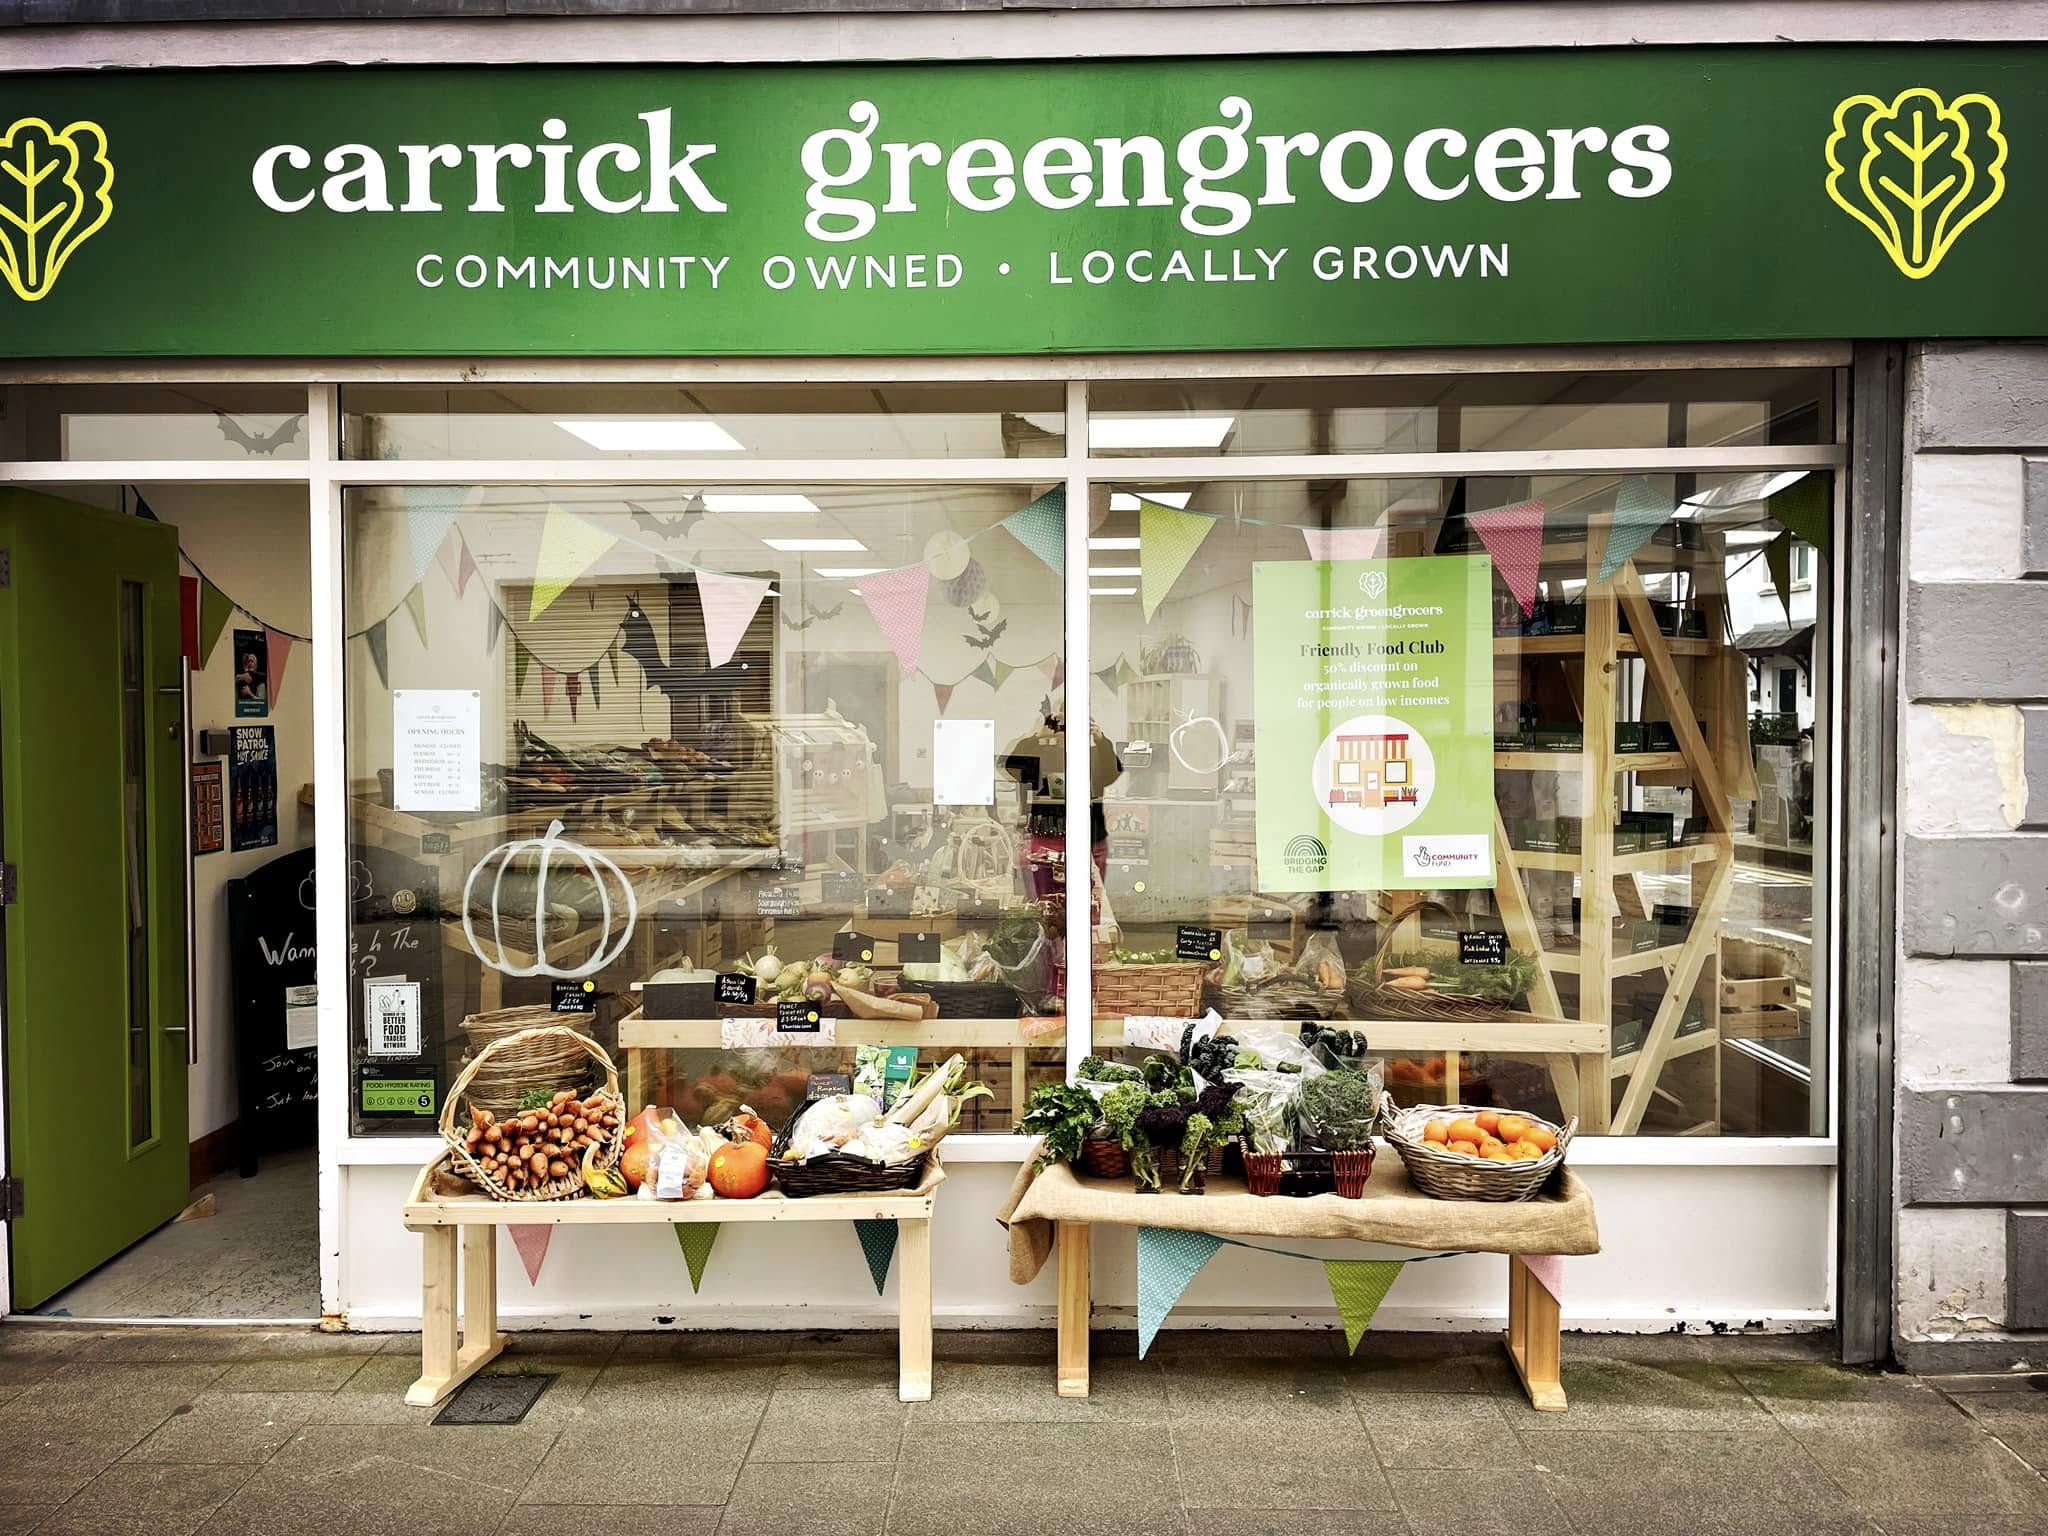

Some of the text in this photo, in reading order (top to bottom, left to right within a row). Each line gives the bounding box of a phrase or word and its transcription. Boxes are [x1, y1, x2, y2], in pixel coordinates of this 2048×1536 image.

[252, 95, 1672, 242] carrick greengrocers
[416, 243, 1509, 290] COMMUNITY OWNED LOCALLY GROWN
[1305, 604, 1444, 620] carrick greengrocers
[1300, 640, 1445, 658] Friendly Food Club
[1323, 661, 1418, 675] 50% discount on
[1303, 676, 1439, 692] organically grown food
[1297, 694, 1450, 711] for people on low incomes
[236, 728, 263, 739] SNOW
[236, 738, 269, 750] PATROL
[236, 750, 269, 763] HOT SAUCE
[1284, 857, 1328, 865] BRIDGING
[258, 932, 317, 966] Wann
[390, 926, 419, 950] The
[383, 1016, 406, 1024] BETTER
[383, 1024, 406, 1035] FOOD
[262, 1055, 295, 1072] Join
[421, 1096, 428, 1106] 5
